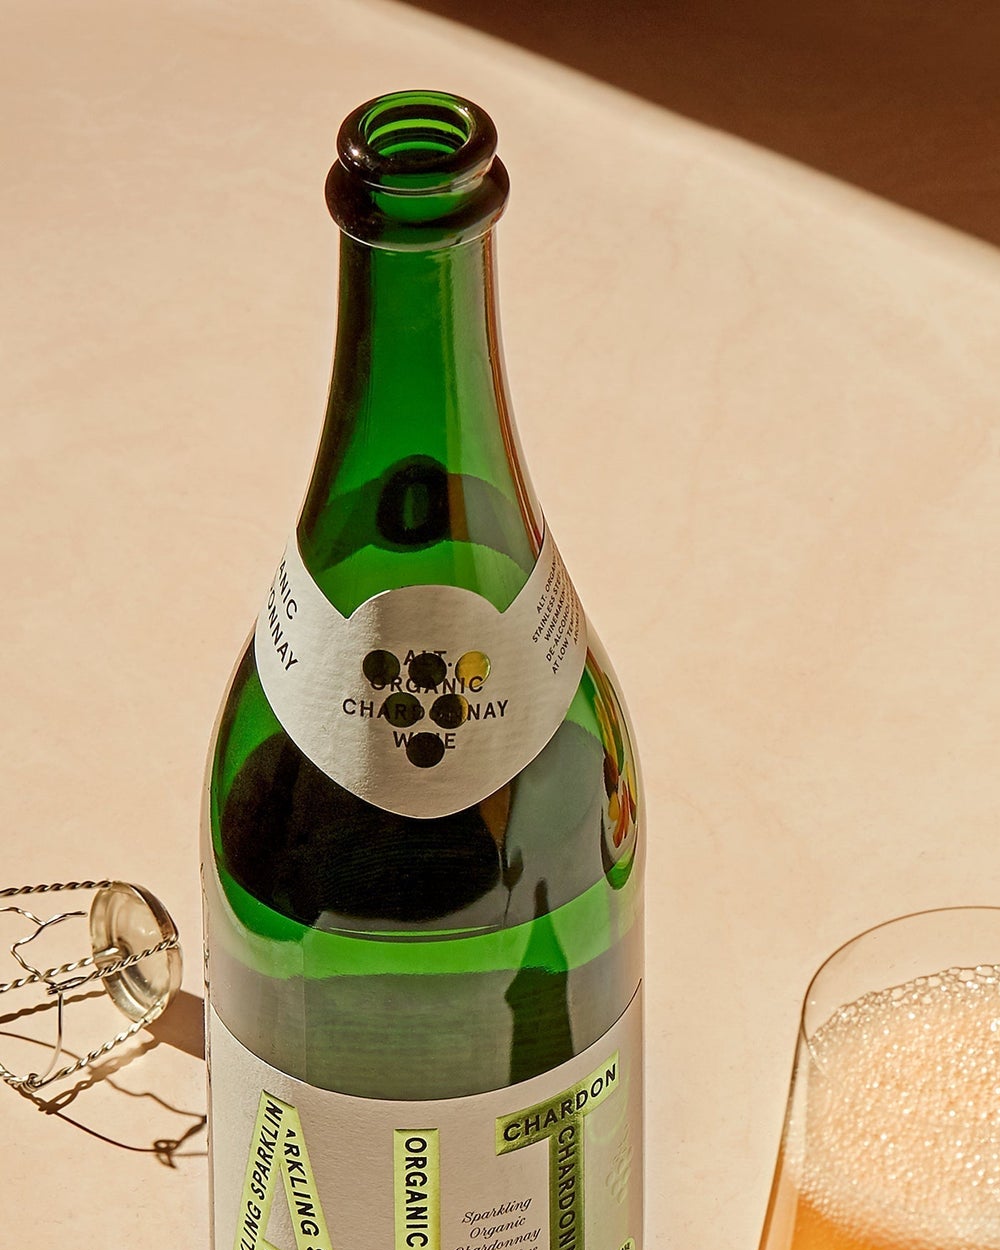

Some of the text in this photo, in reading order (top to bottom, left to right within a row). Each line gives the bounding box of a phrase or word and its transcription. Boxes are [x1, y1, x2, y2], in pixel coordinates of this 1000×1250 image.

[532, 596, 555, 643] STAINLESS
[536, 595, 548, 614] ALT.
[268, 587, 299, 671] ONNAY
[552, 638, 570, 675] AT LOW
[393, 731, 456, 749] WE
[503, 1064, 616, 1142] CHARDON
[250, 1100, 284, 1201] SPARKLIN
[405, 1137, 429, 1248] ORGANIC
[461, 1198, 533, 1225] Sparkling
[469, 1215, 526, 1240] Organic
